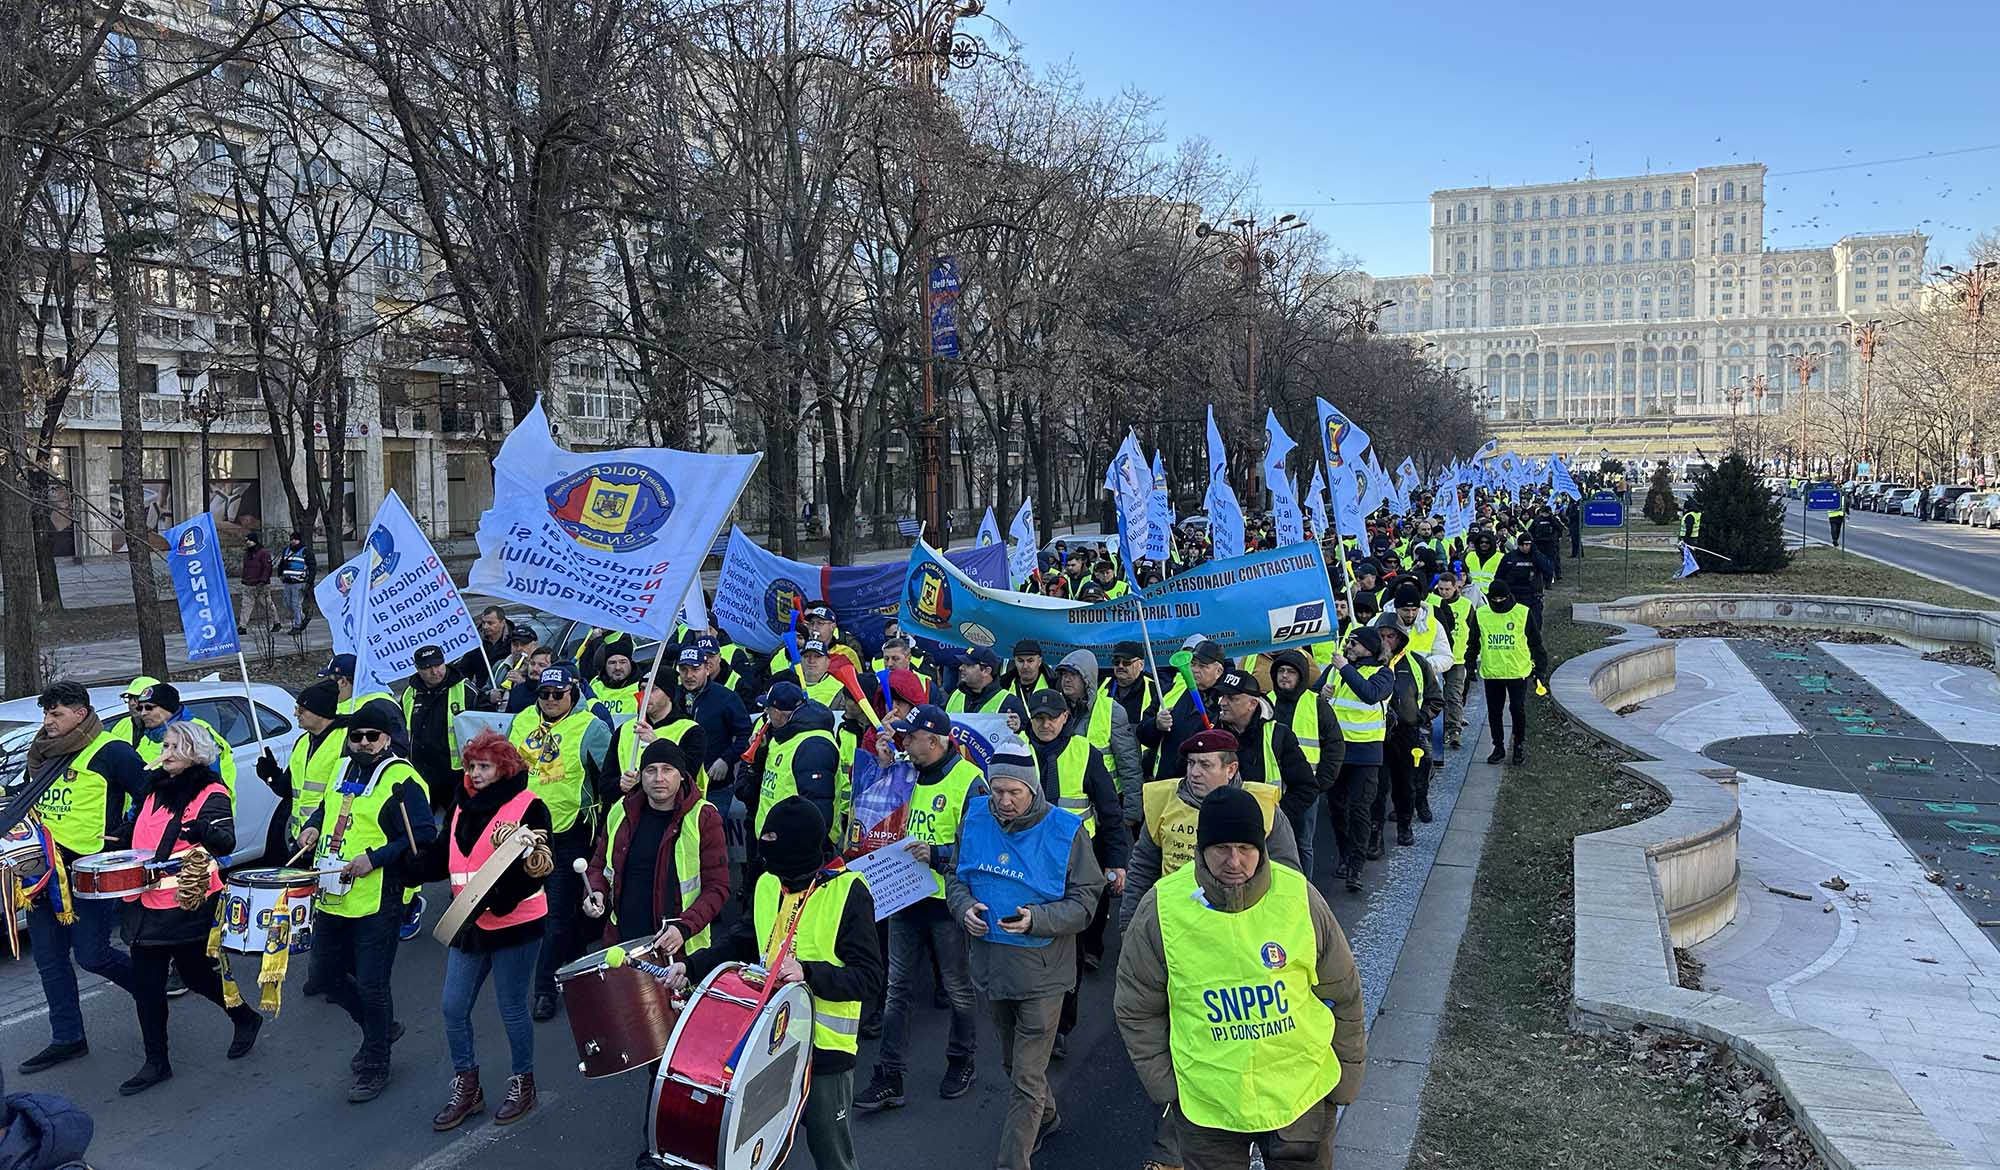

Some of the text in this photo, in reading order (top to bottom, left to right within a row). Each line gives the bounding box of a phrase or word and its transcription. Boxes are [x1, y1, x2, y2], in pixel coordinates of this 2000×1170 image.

[1169, 573, 1238, 595] PERSONALUL
[1239, 552, 1317, 583] CONTRACTUAL
[1068, 606, 1109, 625] BIROUL
[1175, 601, 1202, 619] DOLJ
[698, 639, 713, 648] IPA
[1487, 633, 1516, 646] SNPPC
[604, 699, 624, 714] PPC
[969, 735, 988, 759] Trade
[868, 830, 898, 841] SNPPC
[1203, 979, 1289, 1024] SNPPC
[1210, 1015, 1296, 1042] IPJ CONSTANTA
